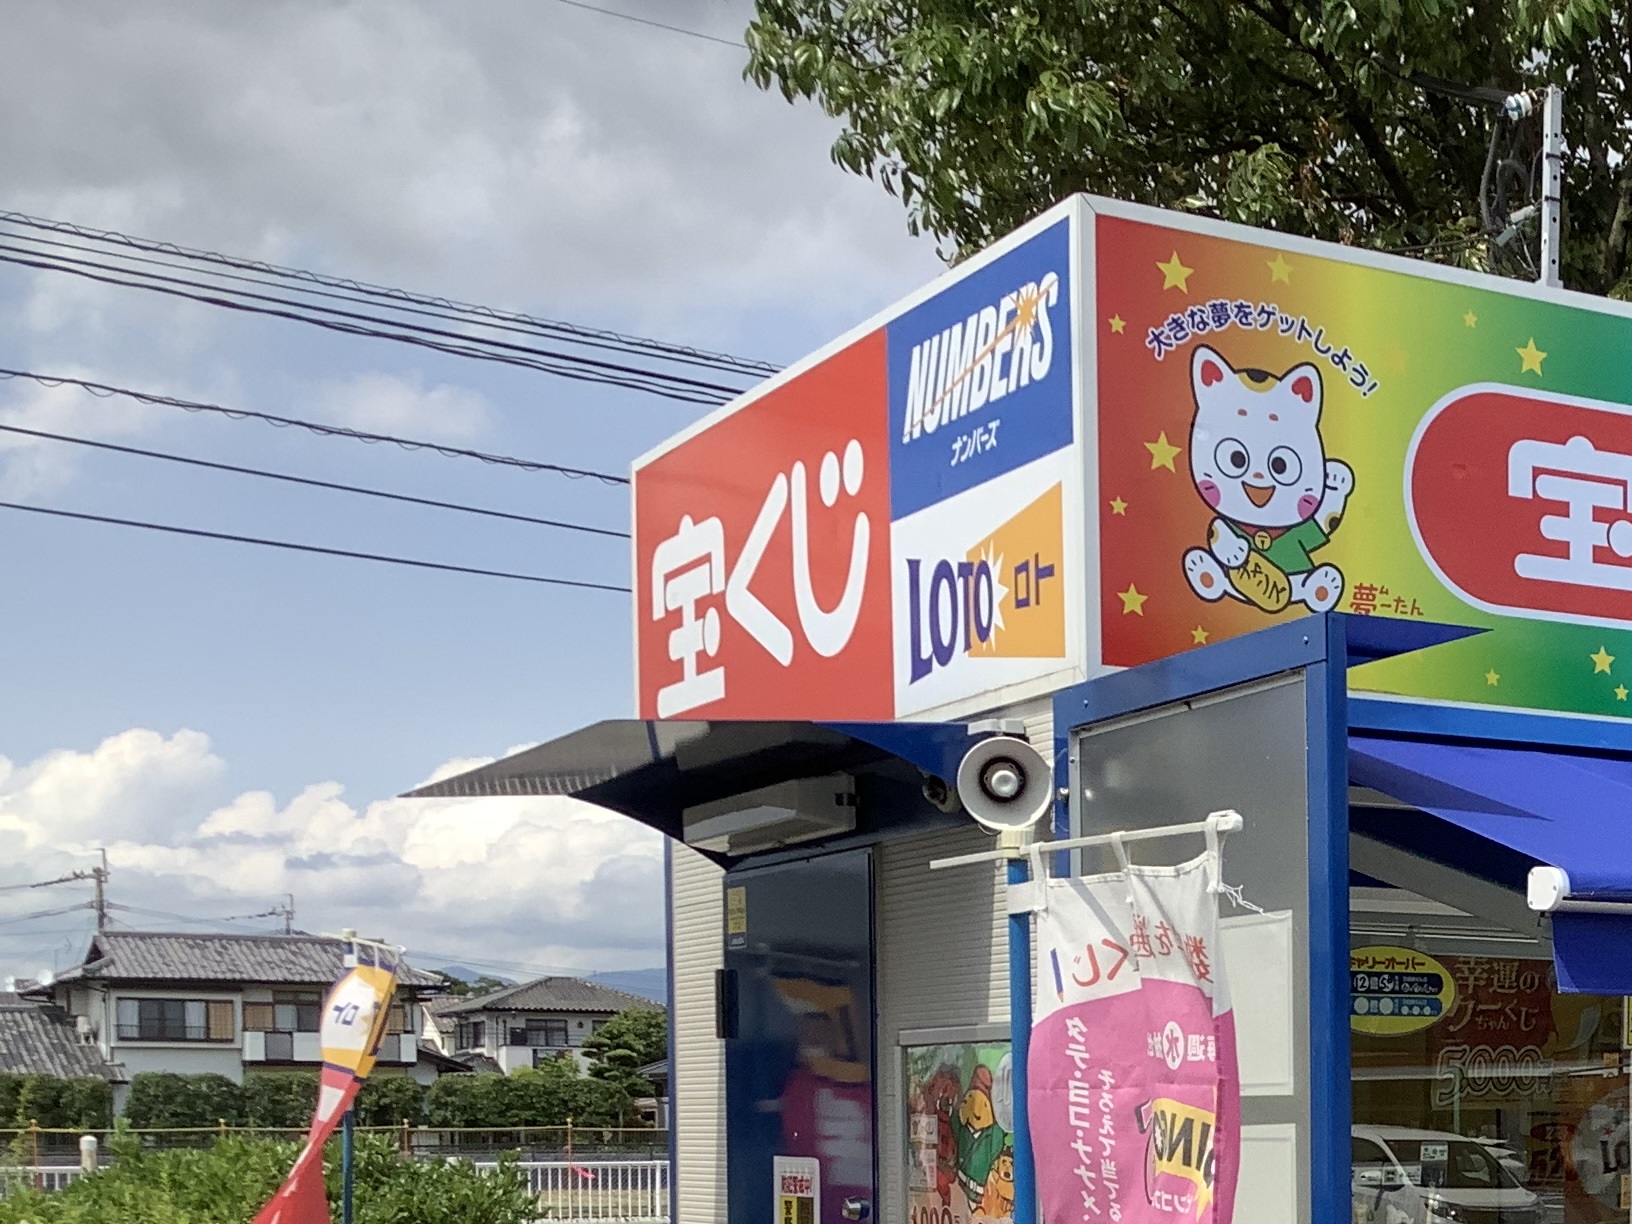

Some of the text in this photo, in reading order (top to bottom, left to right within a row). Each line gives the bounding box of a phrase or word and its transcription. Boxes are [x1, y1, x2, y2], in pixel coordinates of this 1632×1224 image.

[902, 271, 1059, 443] NUMBERS
[1146, 299, 1378, 398] 大きな夢をゲットしよう!
[951, 419, 999, 467] ナンバーズ
[652, 439, 870, 719] 宝くじ
[906, 558, 994, 685] LOTO
[1014, 552, 1055, 611] ロト
[1453, 956, 1541, 995] 幸運の
